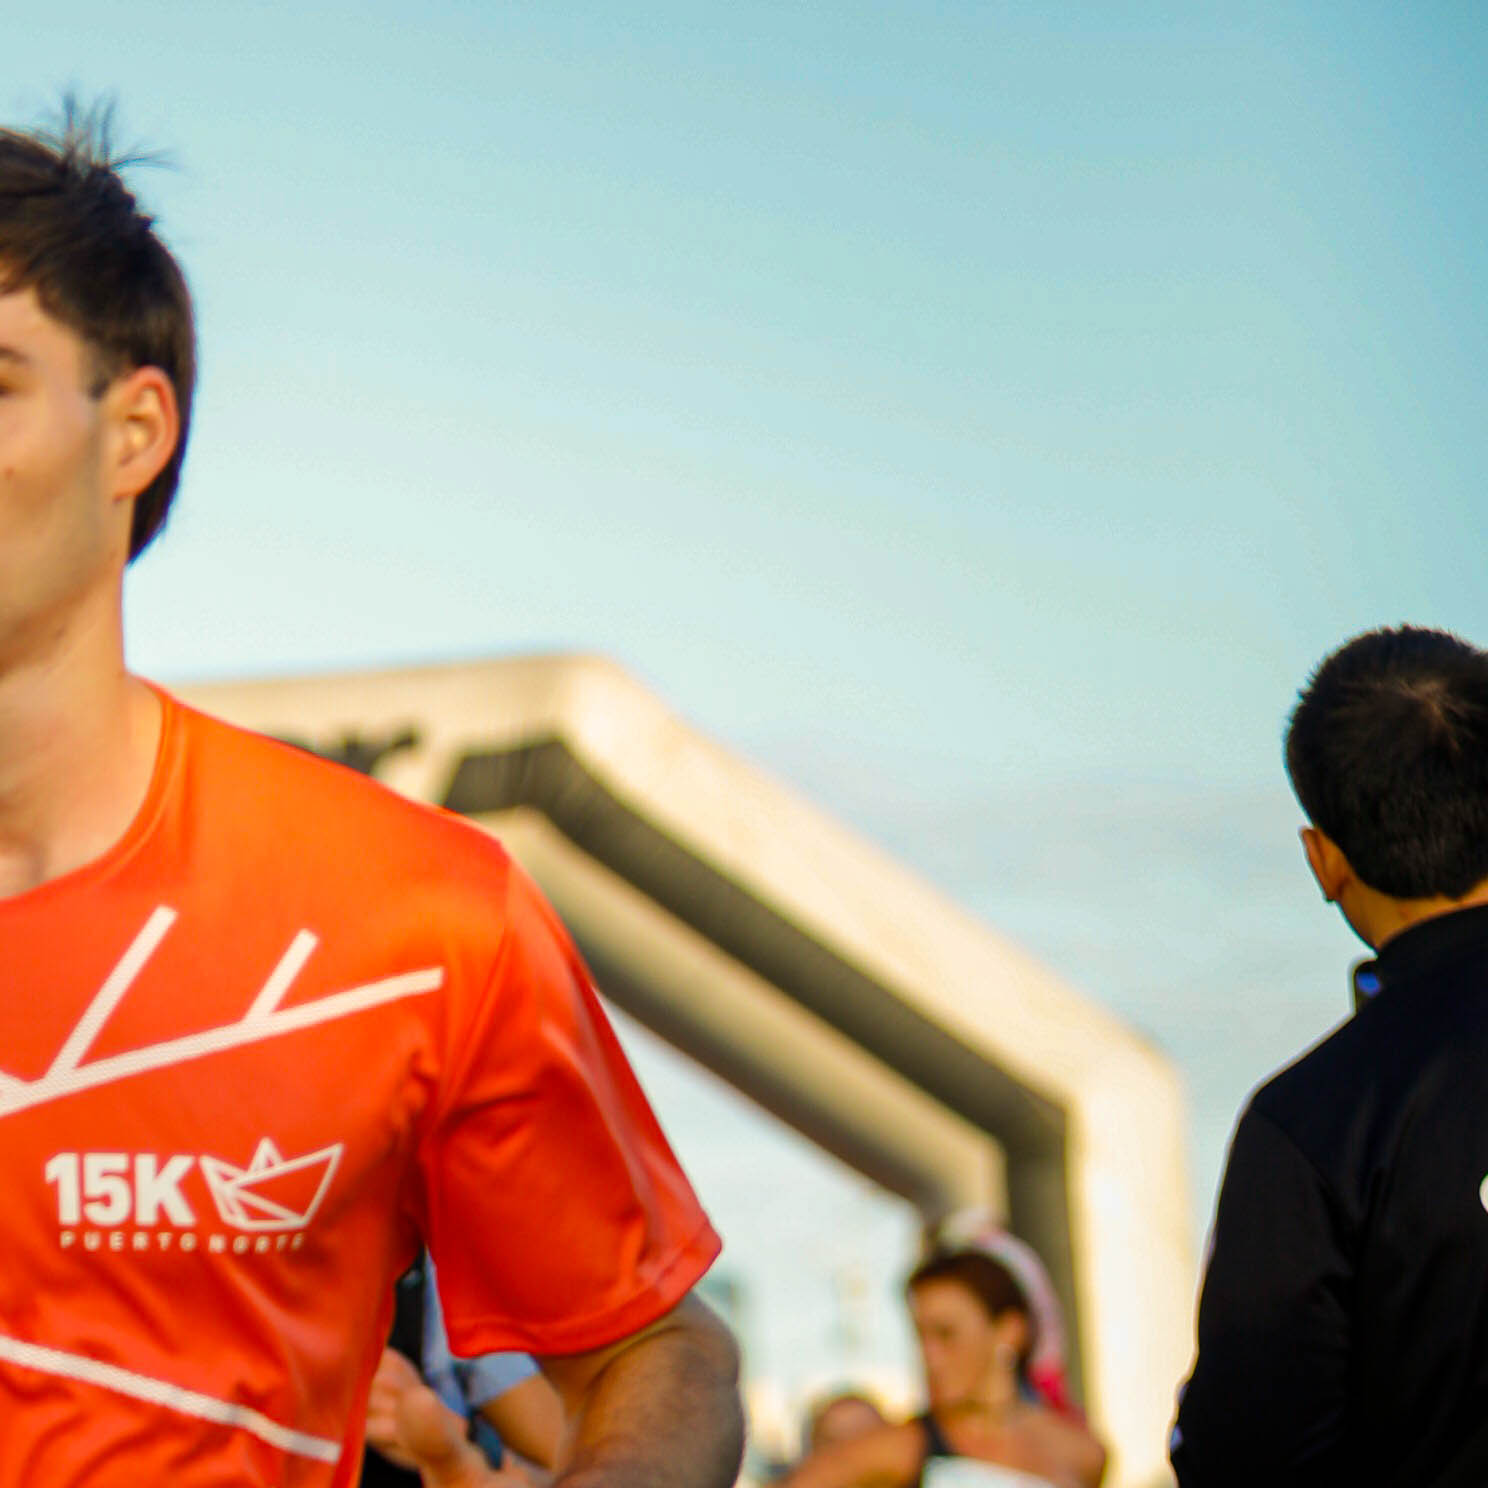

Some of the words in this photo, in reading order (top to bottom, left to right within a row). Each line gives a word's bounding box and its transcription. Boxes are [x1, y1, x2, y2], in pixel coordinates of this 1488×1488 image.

[45, 1152, 196, 1227] 15K
[60, 1230, 197, 1252] PUERTO
[209, 1232, 305, 1254] NORTE
